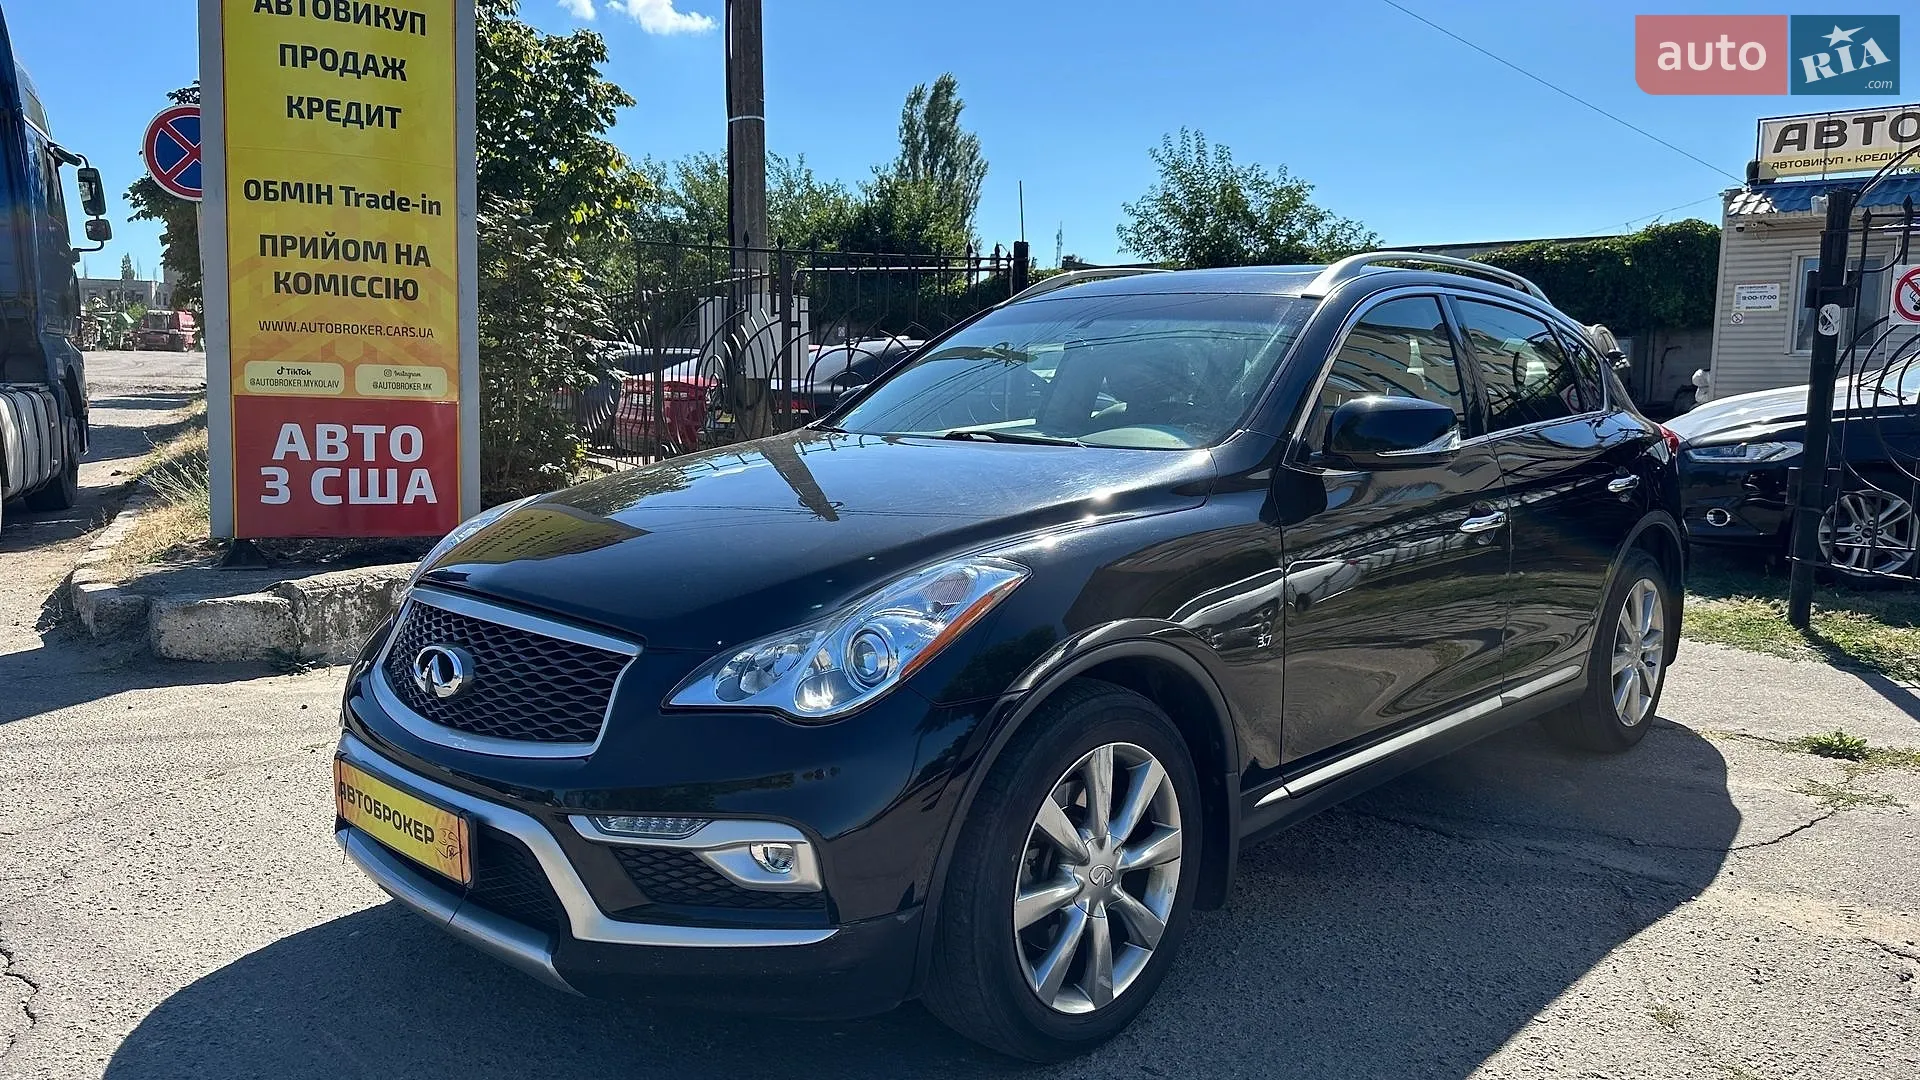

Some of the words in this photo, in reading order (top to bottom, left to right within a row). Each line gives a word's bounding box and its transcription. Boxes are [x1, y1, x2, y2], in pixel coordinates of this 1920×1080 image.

[253, 0, 427, 36] АВТОВИКУП
[279, 43, 408, 82] ПРОДАЖ
[286, 95, 402, 130] КРЕДИТ
[1771, 156, 1844, 170] АВТОВИКУП
[243, 179, 333, 205] ОБМІН
[339, 185, 442, 216] Trade-in
[259, 231, 388, 264] ПРИЙОМ
[395, 243, 431, 268] НА
[273, 271, 419, 301] КОМІССІЮ
[258, 320, 434, 339] WWW.AUTOBROKER.CARS.UA
[286, 368, 312, 376] TikTok
[272, 423, 424, 463] АВТО
[310, 467, 438, 505] США
[338, 781, 435, 845] АВТОБРОКЕР
